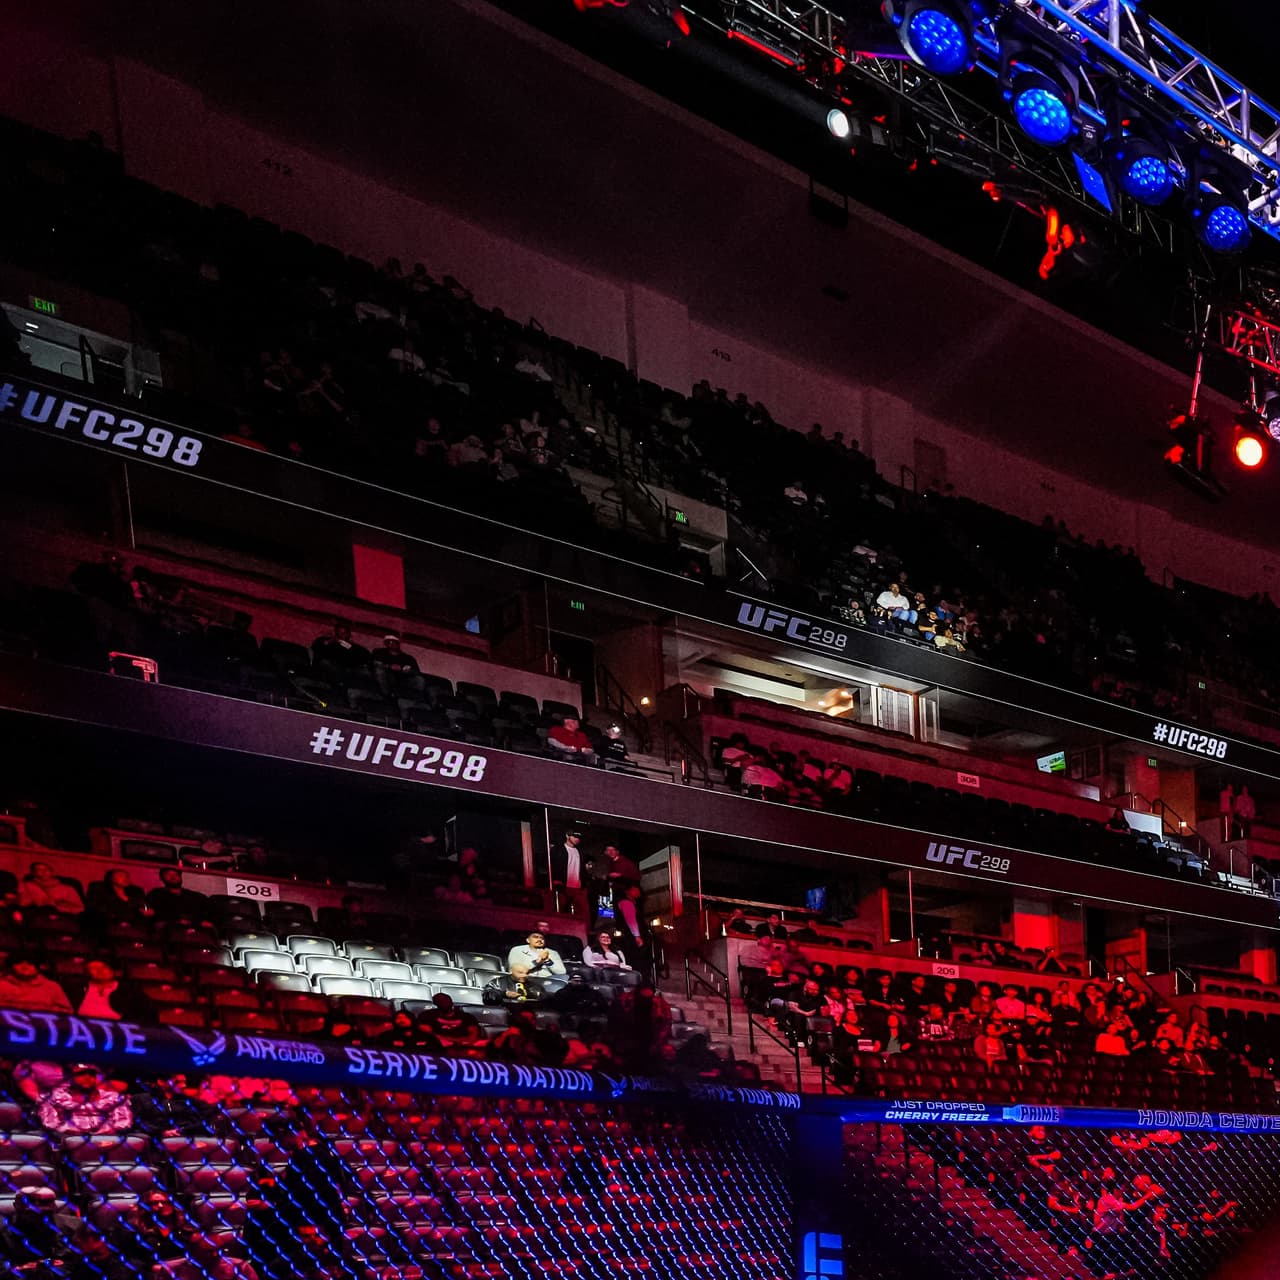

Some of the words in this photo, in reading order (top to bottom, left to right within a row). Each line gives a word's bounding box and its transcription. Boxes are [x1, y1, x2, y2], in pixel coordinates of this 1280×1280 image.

[0, 382, 204, 467] #UFC298
[1152, 722, 1227, 759] #UFC298
[309, 726, 488, 782] #UFC298
[926, 842, 981, 869] UFC
[236, 884, 272, 897] 208
[1, 1010, 147, 1054] STATE
[277, 1049, 325, 1065] GUARD
[345, 1047, 439, 1080] SERVE
[440, 1057, 509, 1086] YOUR
[513, 1064, 594, 1092] NATION
[884, 1111, 937, 1121] CHERRY
[940, 1111, 989, 1122] FREEZE
[890, 1101, 922, 1110] JUST
[926, 1101, 985, 1112] DROPPED
[1018, 1106, 1060, 1123] PRIME
[1138, 1109, 1213, 1127] HONDA
